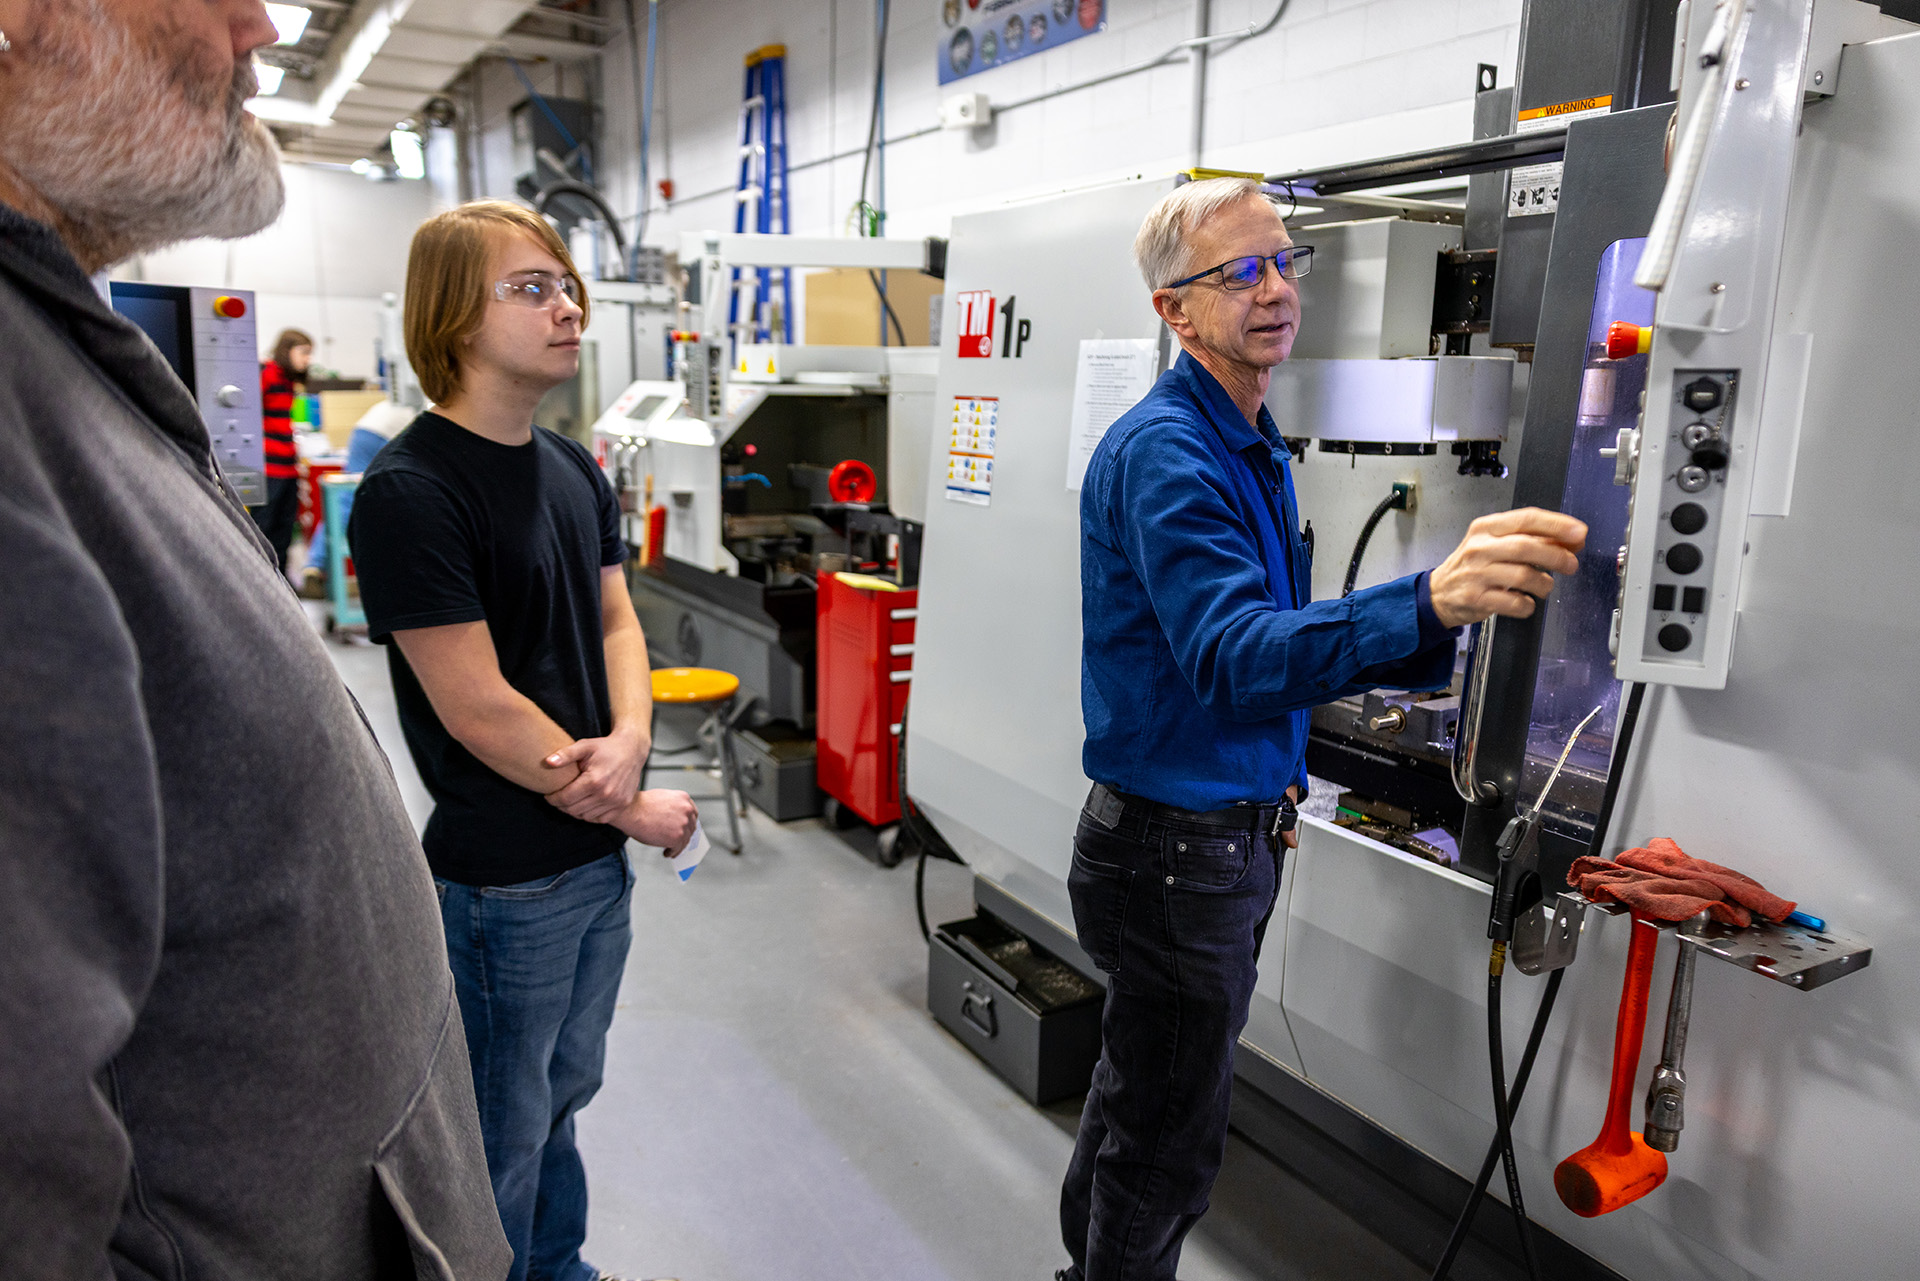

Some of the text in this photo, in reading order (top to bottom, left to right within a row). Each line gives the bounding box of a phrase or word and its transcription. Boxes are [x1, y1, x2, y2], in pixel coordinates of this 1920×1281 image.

[1546, 98, 1596, 115] WARNING
[1347, 441, 1425, 455] 6 5 4
